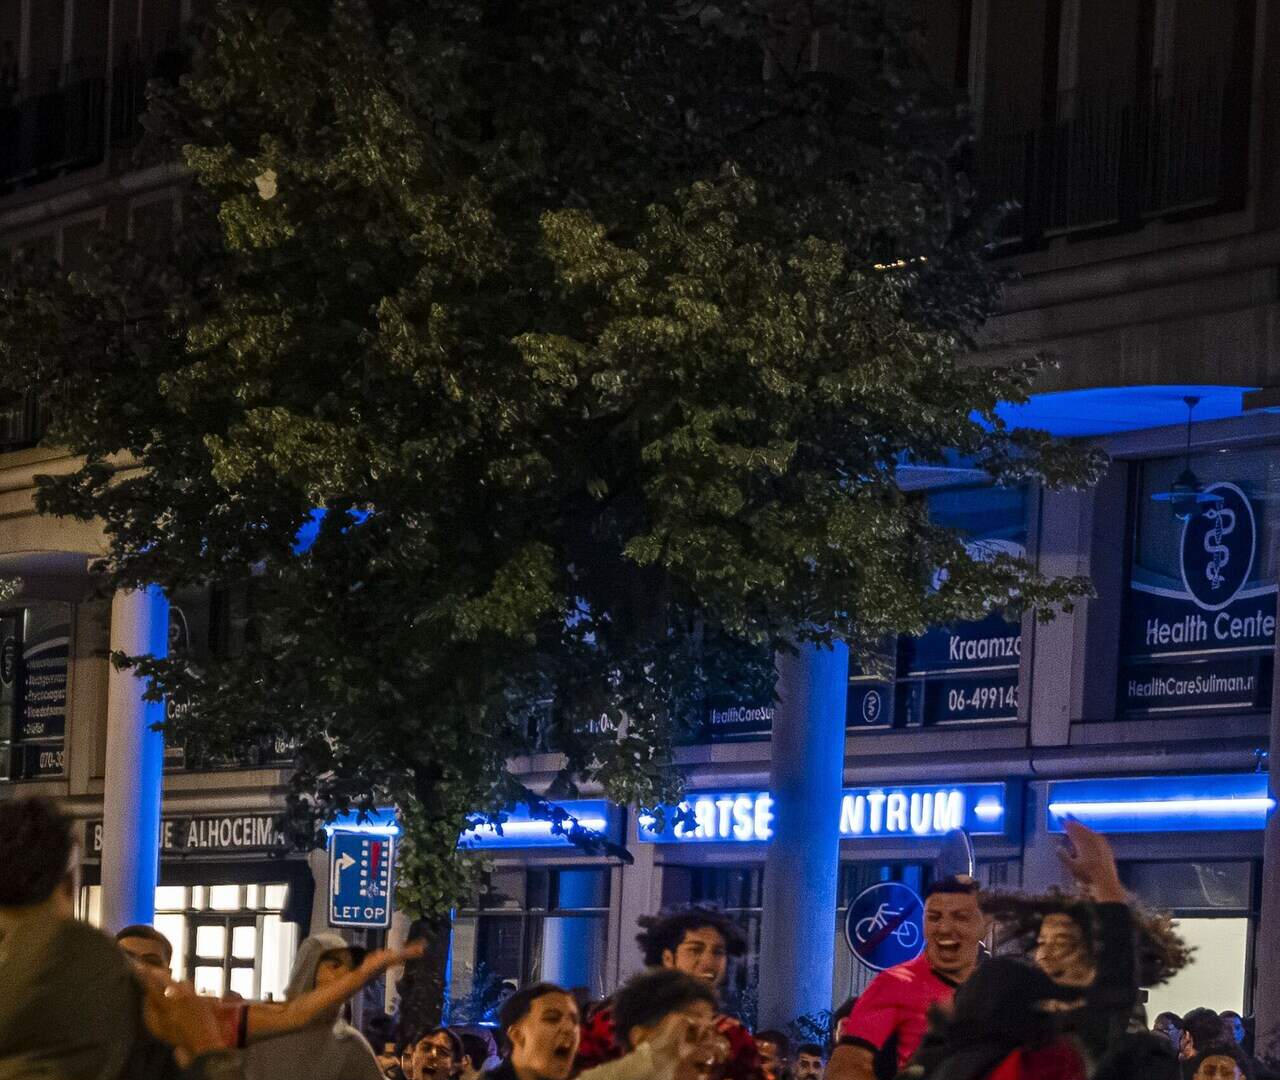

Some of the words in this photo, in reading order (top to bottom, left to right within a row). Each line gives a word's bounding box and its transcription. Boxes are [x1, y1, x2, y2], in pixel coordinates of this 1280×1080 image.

[1145, 614, 1207, 646] Health
[333, 906, 360, 918] LET
[363, 907, 385, 919] OP
